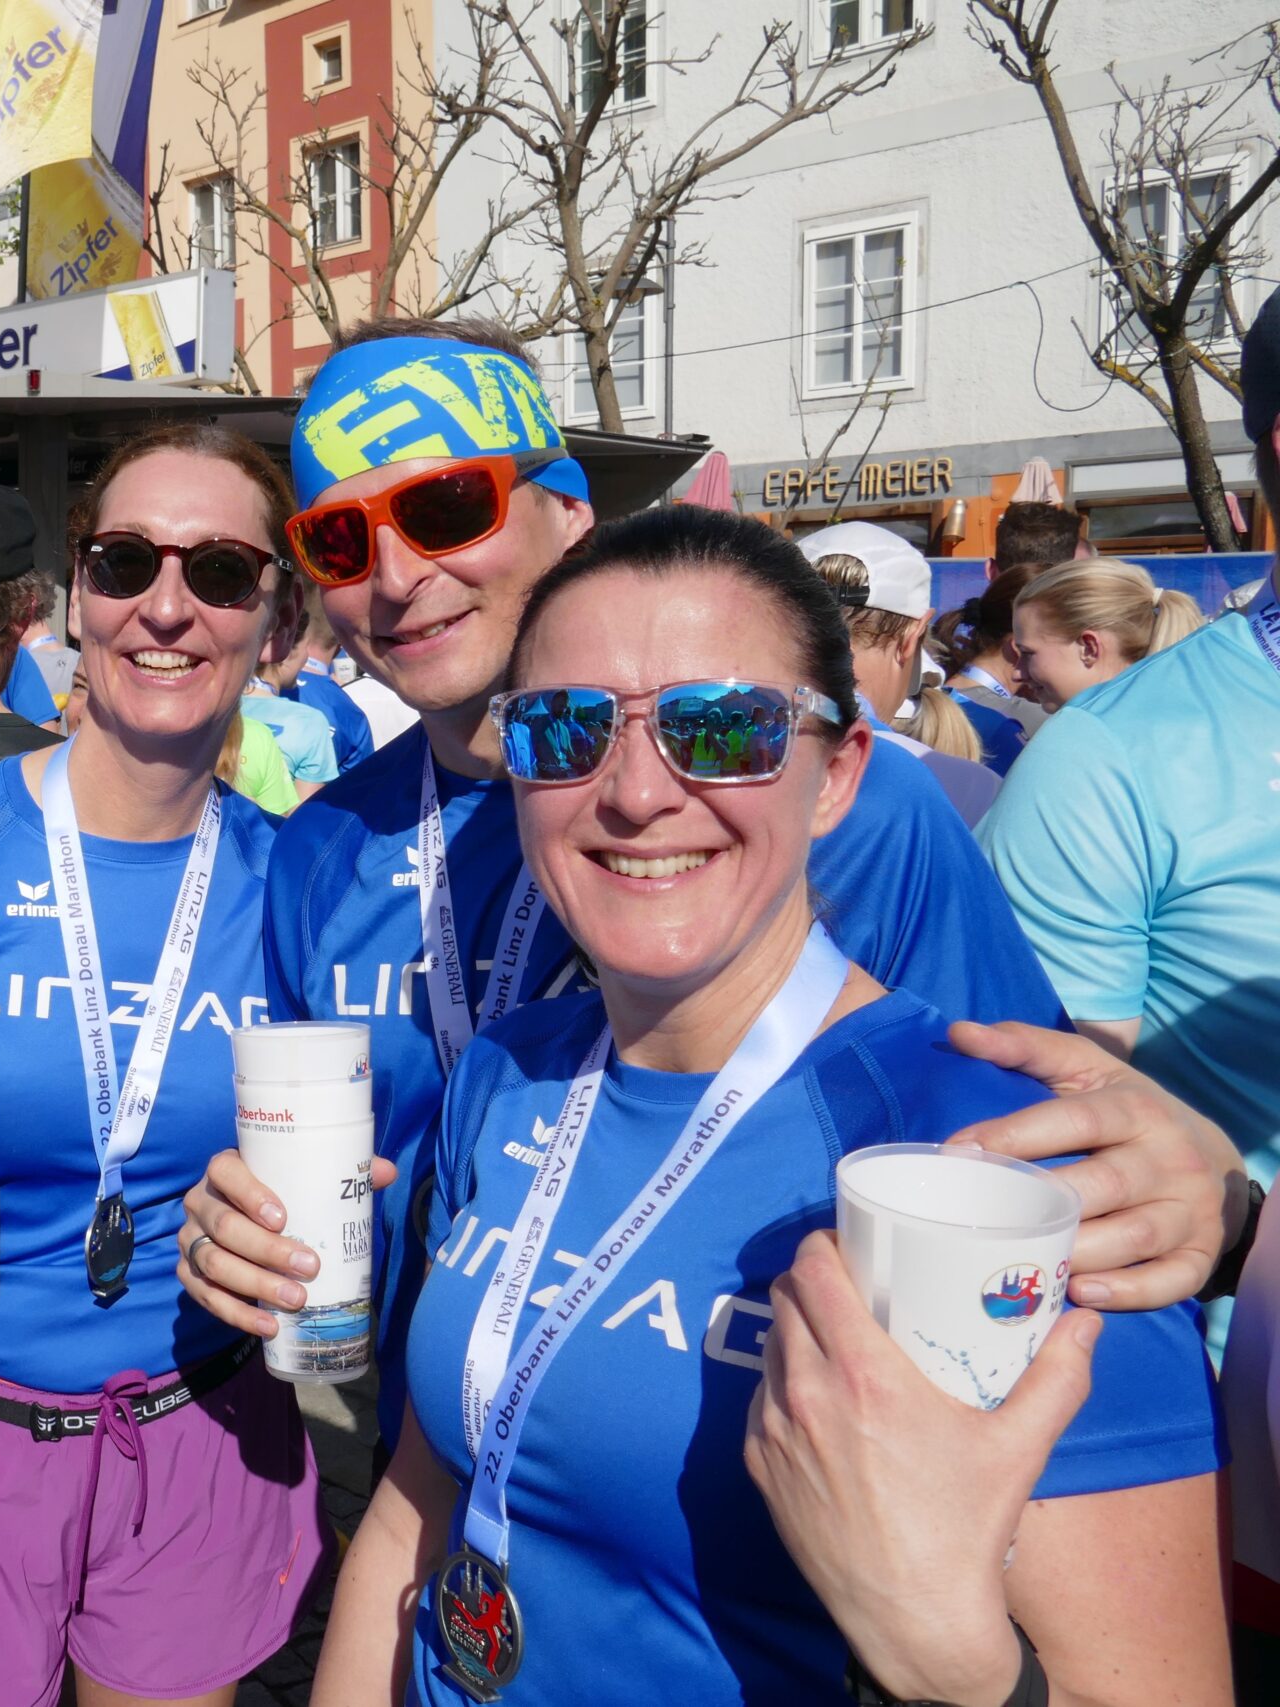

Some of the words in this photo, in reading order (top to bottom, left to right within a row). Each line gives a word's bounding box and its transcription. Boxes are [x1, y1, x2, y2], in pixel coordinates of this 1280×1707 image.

[50, 214, 119, 297] Zipfer
[140, 351, 166, 376] Zipfer
[765, 467, 841, 501] CAFE
[861, 457, 953, 497] MEIER
[422, 802, 431, 888] Viertelmarathon
[58, 834, 83, 918] Marathon
[184, 872, 208, 929] LINZ
[392, 869, 419, 886] eri
[168, 870, 195, 946] Viertelmarathon
[76, 924, 94, 980] Donau
[180, 929, 194, 954] AG
[430, 956, 438, 970] 5k
[441, 929, 465, 1005] GENERALI
[489, 973, 513, 1022] bank
[502, 927, 525, 968] Linz
[83, 986, 102, 1022] Linz
[146, 1004, 158, 1018] 5k
[150, 987, 180, 1055] GENERALI
[87, 1030, 112, 1115] Oberbank
[440, 1030, 454, 1072] Staffelm
[113, 1066, 137, 1134] Staffelmarathon
[237, 1105, 294, 1123] Oberbank
[561, 1085, 593, 1150] LINZ
[502, 1140, 544, 1168] erim
[533, 1090, 577, 1192] Viertelmarathon
[544, 1155, 568, 1198] AG
[484, 1448, 504, 1485] 22.
[495, 1323, 559, 1441] Oberbank
[557, 1276, 596, 1323] Linz
[593, 1200, 657, 1276] Donau
[655, 1088, 743, 1199] Marathon
[491, 1245, 535, 1338] GENERALI
[492, 1272, 505, 1287] 5k
[473, 1388, 481, 1436] HYUNDAI
